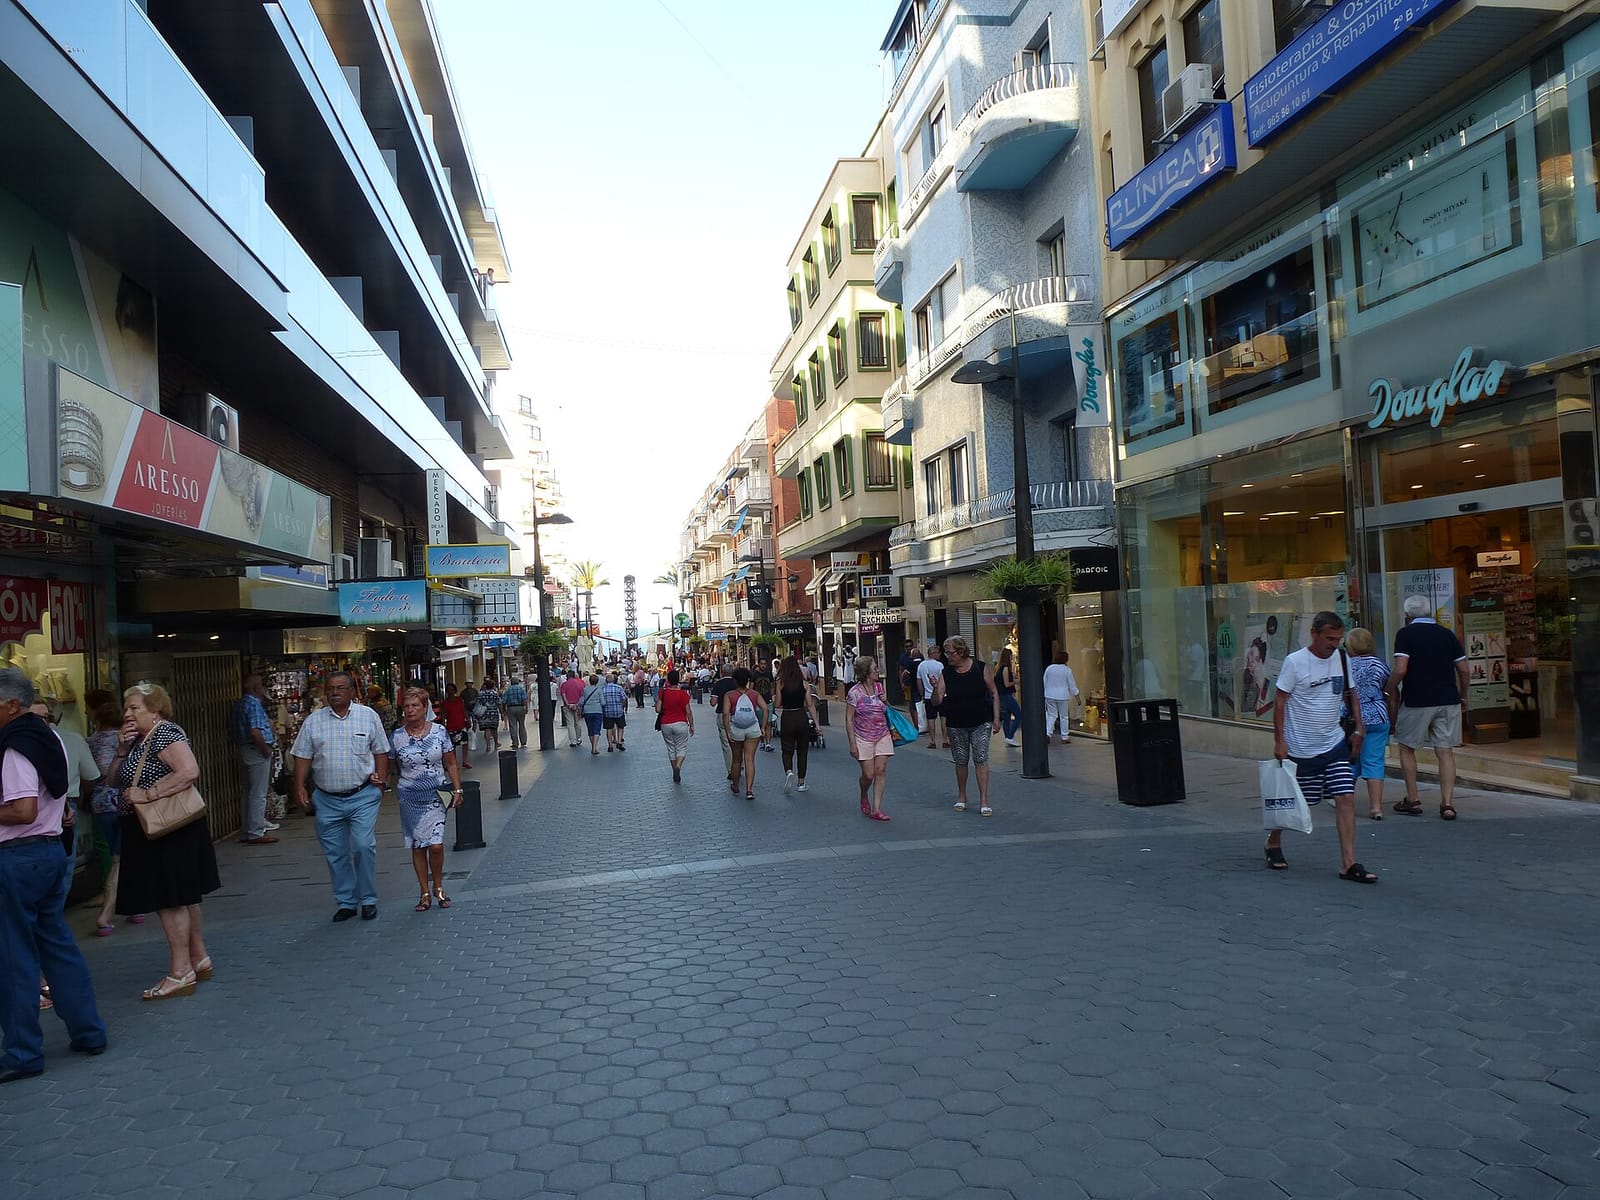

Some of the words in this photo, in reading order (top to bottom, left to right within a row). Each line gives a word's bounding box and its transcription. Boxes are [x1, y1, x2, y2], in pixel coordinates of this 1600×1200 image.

[1405, 8, 1414, 22] B
[1249, 32, 1323, 100] Fisioterapia
[1327, 17, 1340, 34] &
[1253, 62, 1319, 120] Acupuntura
[1321, 50, 1331, 64] &
[1267, 112, 1281, 129] 965
[1292, 96, 1300, 110] 10
[1301, 88, 1310, 102] 61
[1109, 148, 1197, 228] CLÍNICA
[1076, 336, 1102, 414] Douglas
[1367, 345, 1506, 429] Douglas
[134, 460, 199, 503] ARESSO
[432, 472, 441, 521] MERCADO
[273, 511, 305, 537] ARESSO
[833, 560, 858, 568] IBERIA
[1485, 553, 1513, 564] Douglas
[473, 616, 517, 624] PLATA
[861, 615, 901, 624] EXCHANGE
